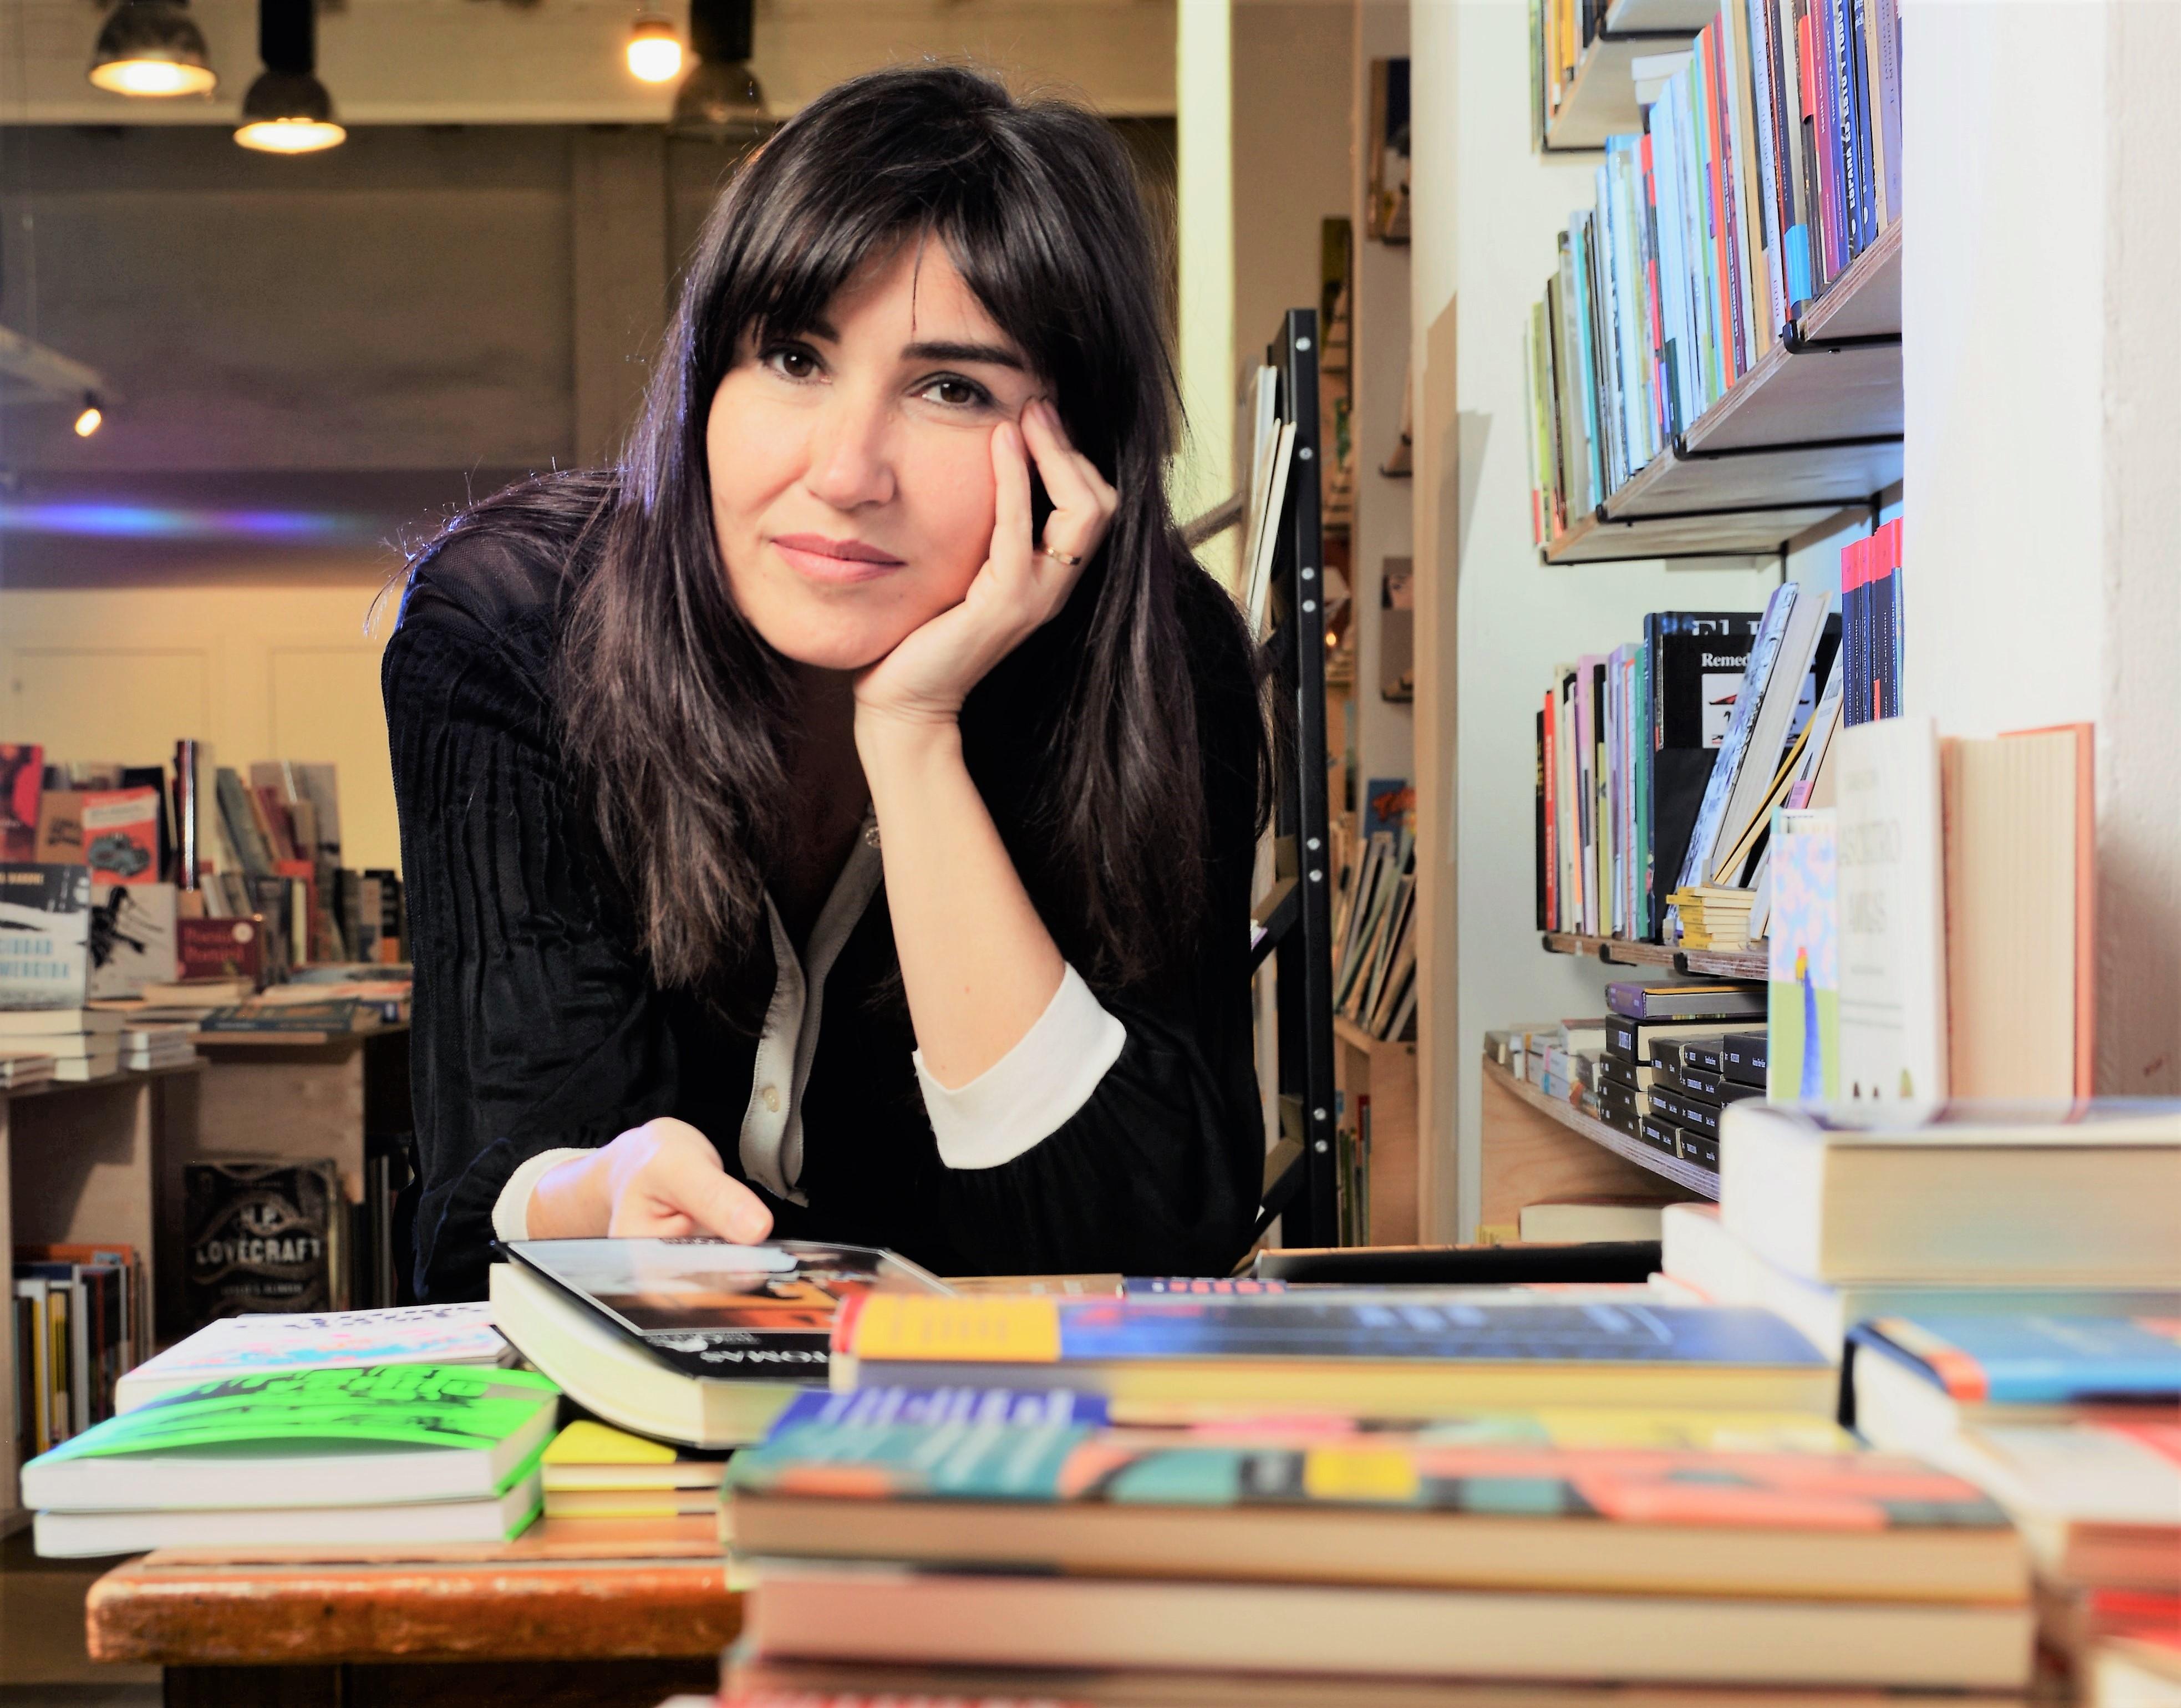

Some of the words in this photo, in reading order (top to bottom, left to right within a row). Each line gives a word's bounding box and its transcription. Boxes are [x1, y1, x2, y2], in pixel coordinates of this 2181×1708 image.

[1841, 60, 1847, 72] Y
[1842, 75, 1850, 118] ESTO
[195, 1237, 321, 1264] LOVECRAFT
